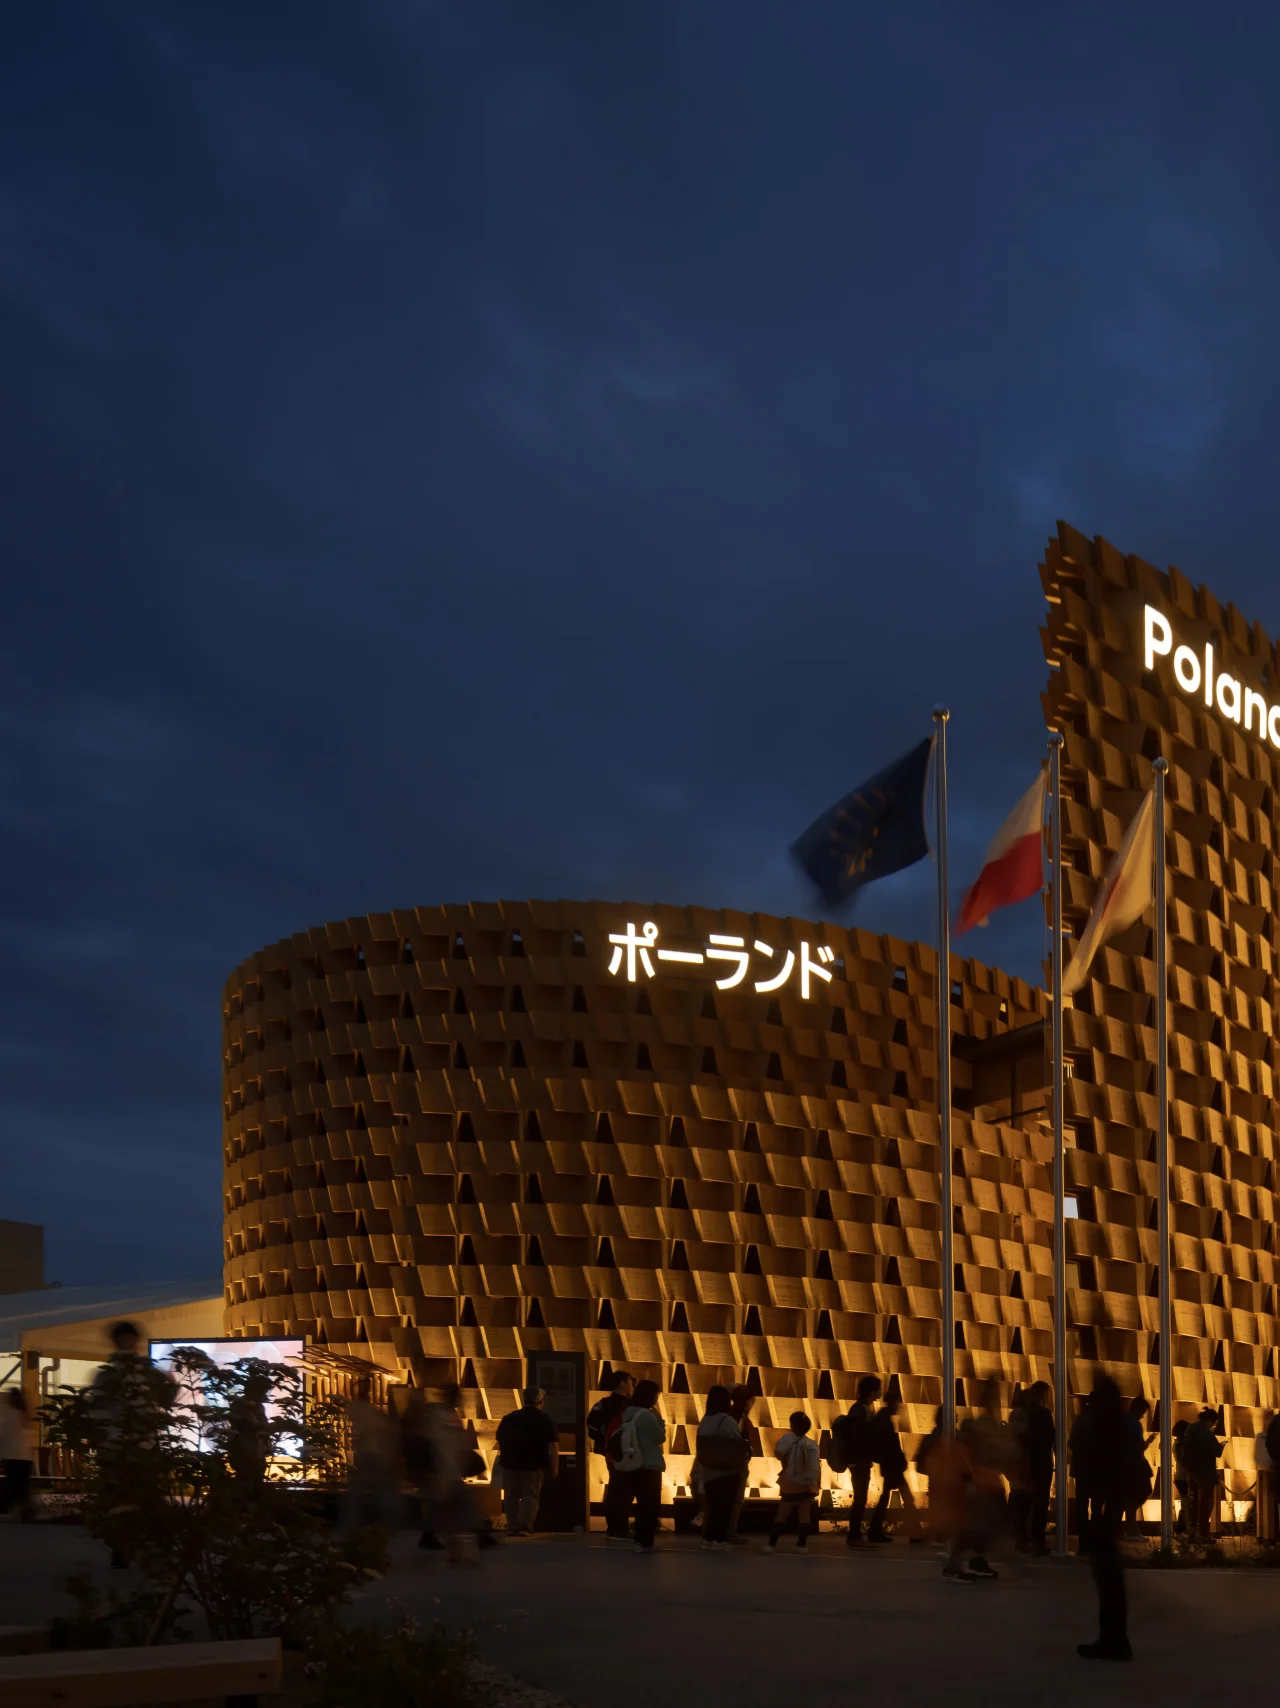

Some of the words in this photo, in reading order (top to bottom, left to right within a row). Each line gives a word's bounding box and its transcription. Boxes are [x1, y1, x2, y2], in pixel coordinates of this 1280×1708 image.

[607, 921, 835, 999] ポーランド
